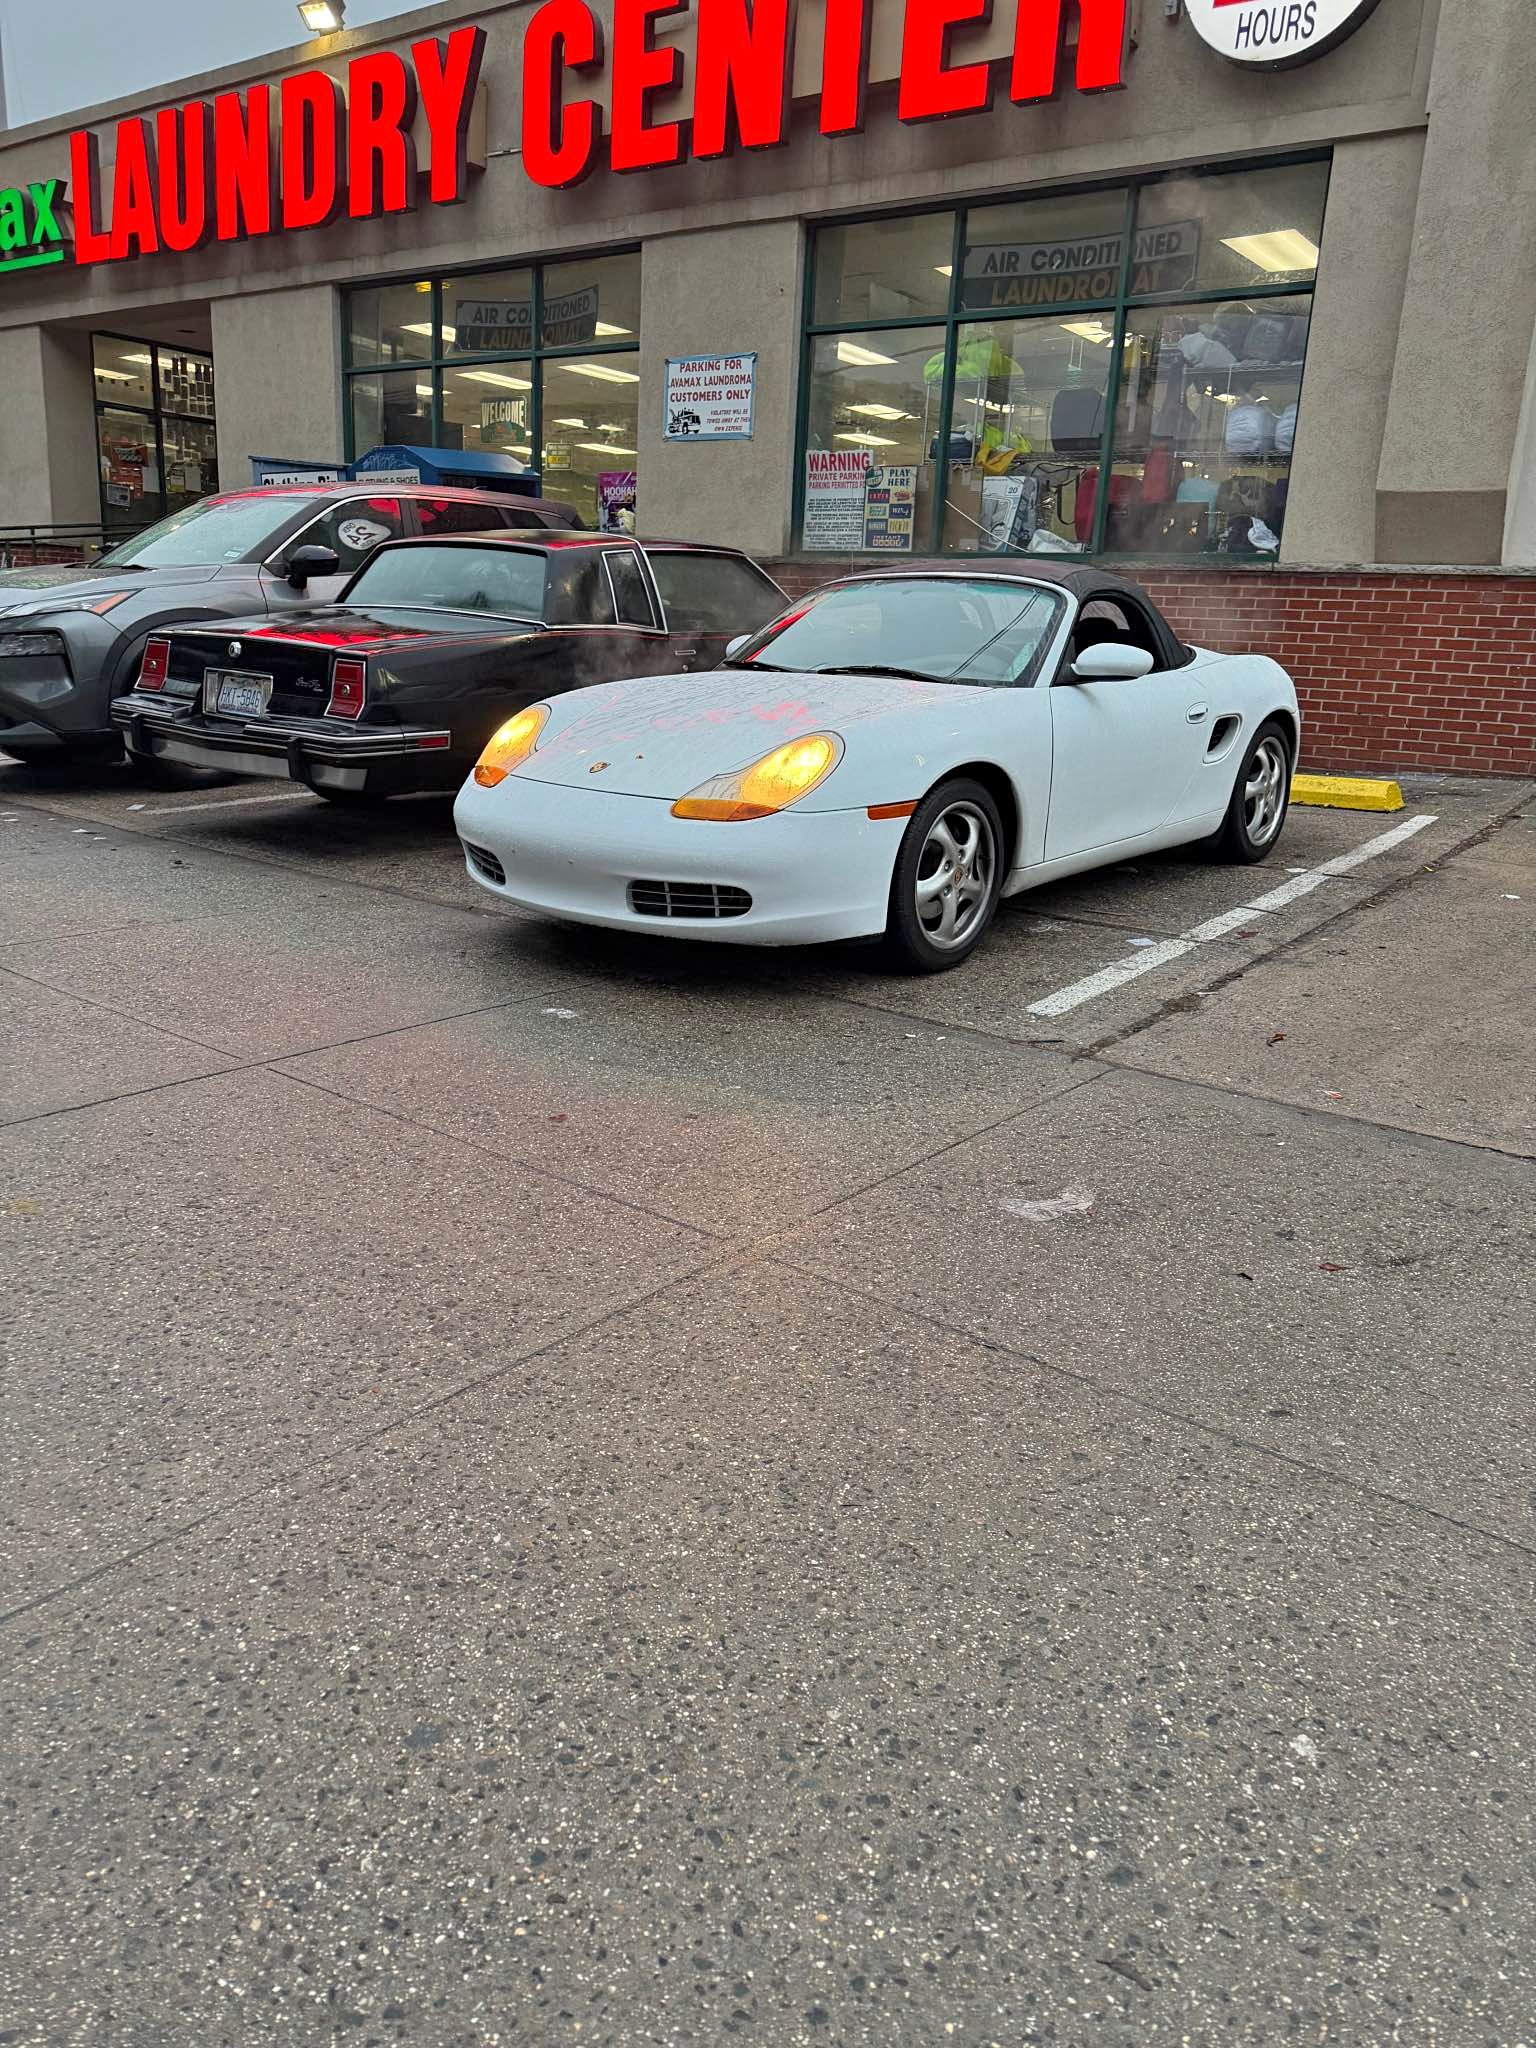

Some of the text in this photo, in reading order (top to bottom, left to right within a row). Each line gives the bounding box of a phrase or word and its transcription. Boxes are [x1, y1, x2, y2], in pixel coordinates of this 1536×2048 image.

[1234, 1, 1317, 49] HOURS
[70, 26, 480, 264] LAUNDRY
[982, 231, 1182, 274] AIR CONDITINED
[991, 265, 1162, 306] LAUNDROAT
[472, 295, 590, 324] AIR CODITIONED
[680, 359, 742, 372] PARKING FOR
[704, 374, 752, 386] LAUNDROMA
[670, 389, 750, 402] CUSTOMERS ONLY
[481, 400, 525, 428] WELCOME
[808, 453, 870, 471] WARNING
[808, 473, 838, 481] PRIVATE
[839, 472, 865, 481] PARKIN
[889, 469, 911, 478] PLAY
[808, 481, 830, 489] PARKING
[831, 481, 859, 489] PERMITTED
[887, 478, 911, 486] HERE
[603, 485, 637, 498] HOOKAH
[1007, 486, 1018, 494] 20
